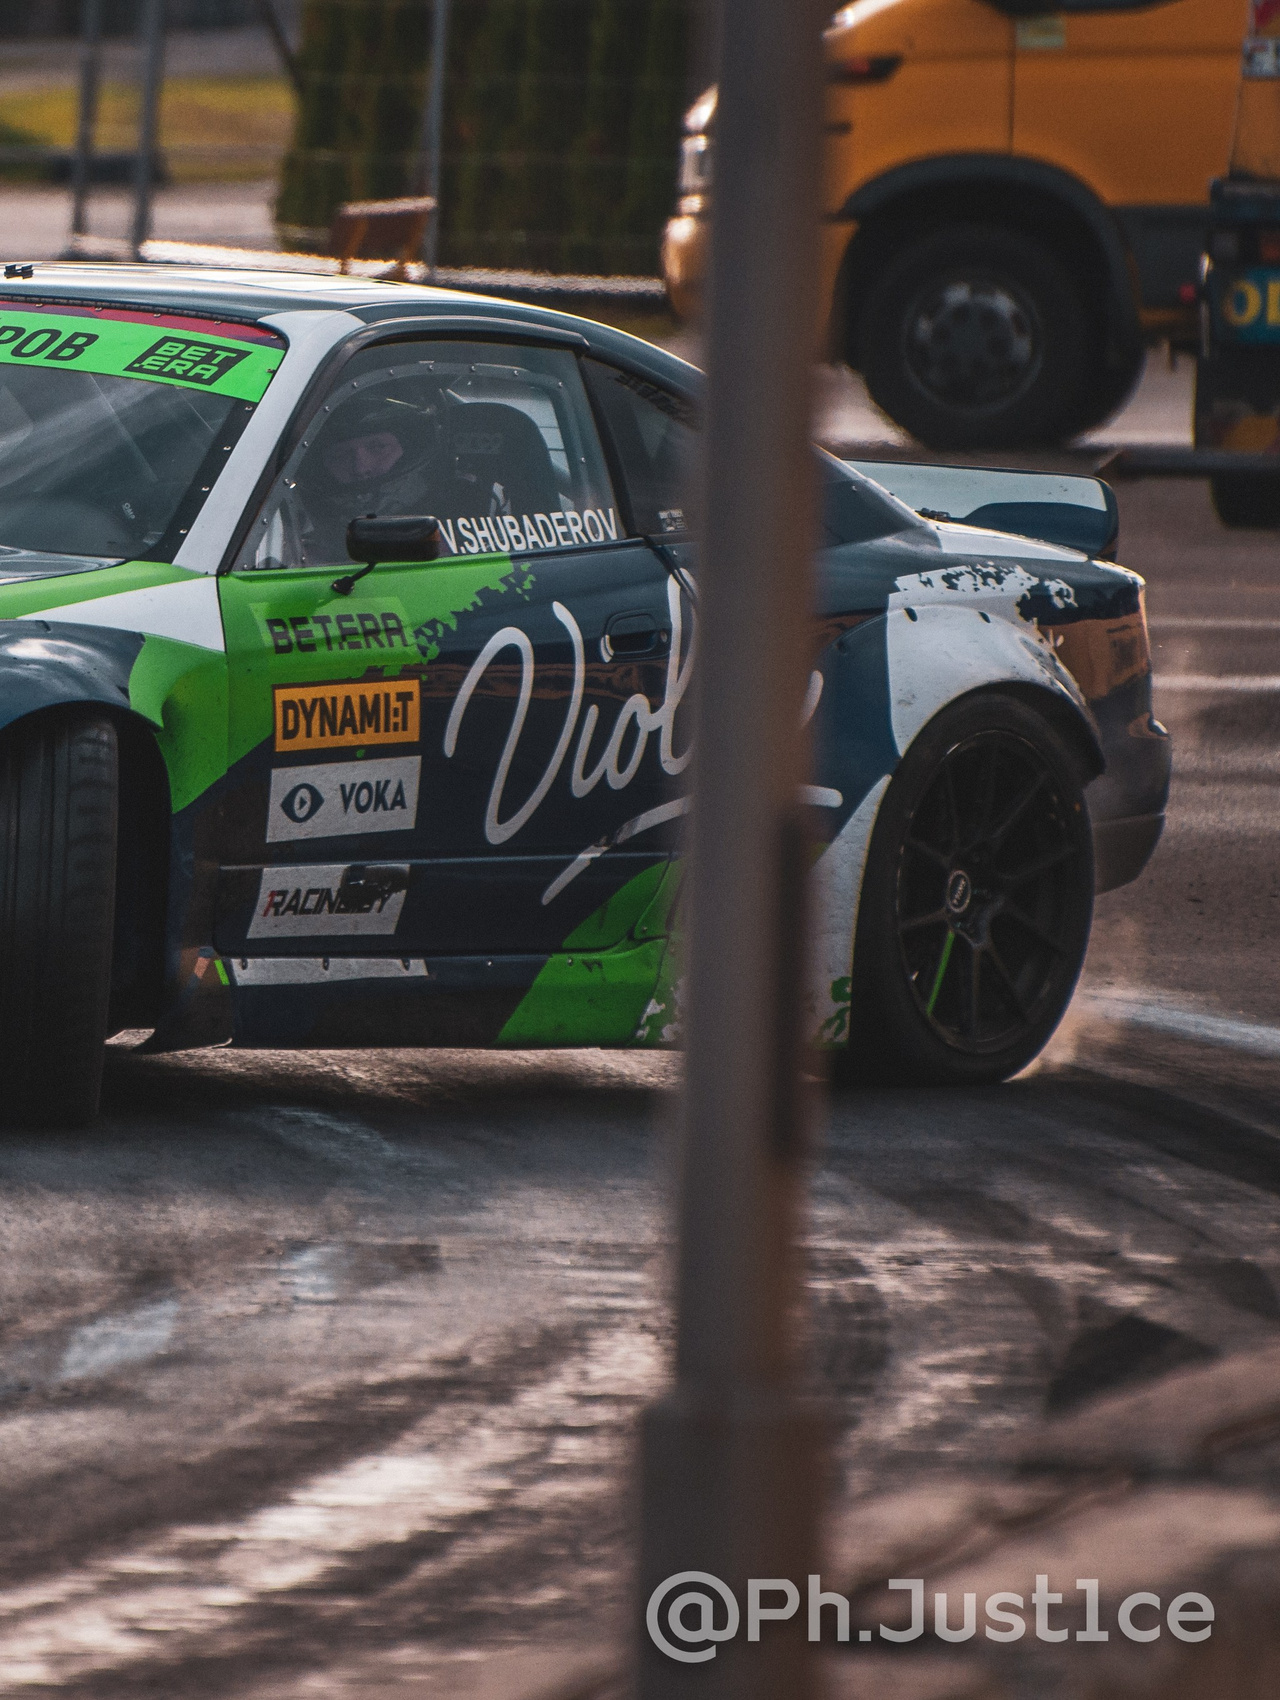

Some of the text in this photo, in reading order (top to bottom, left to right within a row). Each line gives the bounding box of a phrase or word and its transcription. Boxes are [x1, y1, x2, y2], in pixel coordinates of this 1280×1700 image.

[438, 507, 618, 554] V.SHUBADEROV
[282, 691, 414, 740] DYNAMI:T
[339, 778, 408, 815] VOKA
